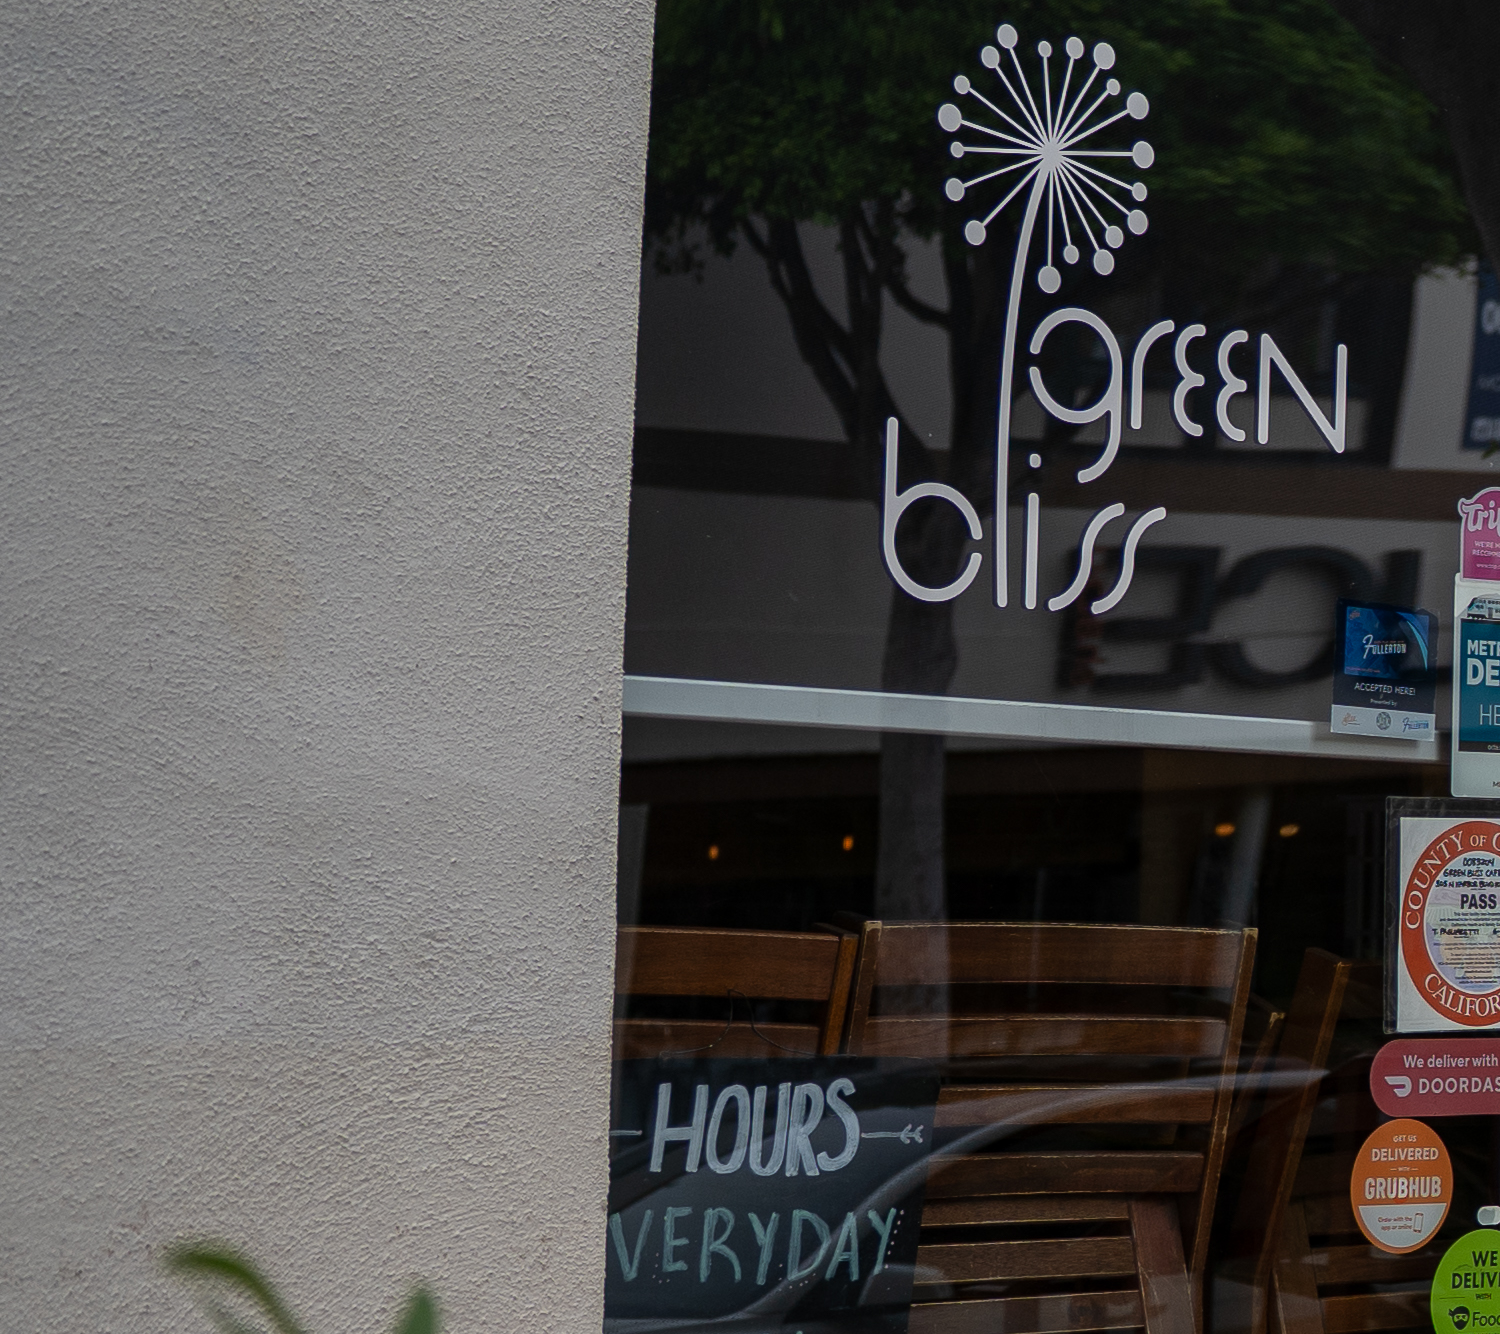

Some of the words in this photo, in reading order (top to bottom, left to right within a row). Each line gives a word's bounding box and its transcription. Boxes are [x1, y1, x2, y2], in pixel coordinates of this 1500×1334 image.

[882, 415, 1167, 614] bliss
[1354, 682, 1392, 693] ACCEPTED
[1405, 830, 1464, 929] COUNTY
[1469, 834, 1488, 847] OF
[1460, 893, 1497, 909] PASS
[1403, 1055, 1424, 1068] We
[1427, 1054, 1470, 1068] deliver
[1472, 1054, 1499, 1067] with
[650, 1078, 860, 1177] HOURS
[1371, 1148, 1439, 1161] DELIVERED
[1364, 1176, 1442, 1199] GRUBHUB
[609, 1206, 897, 1285] VERYDAY
[1472, 1251, 1498, 1267] WE
